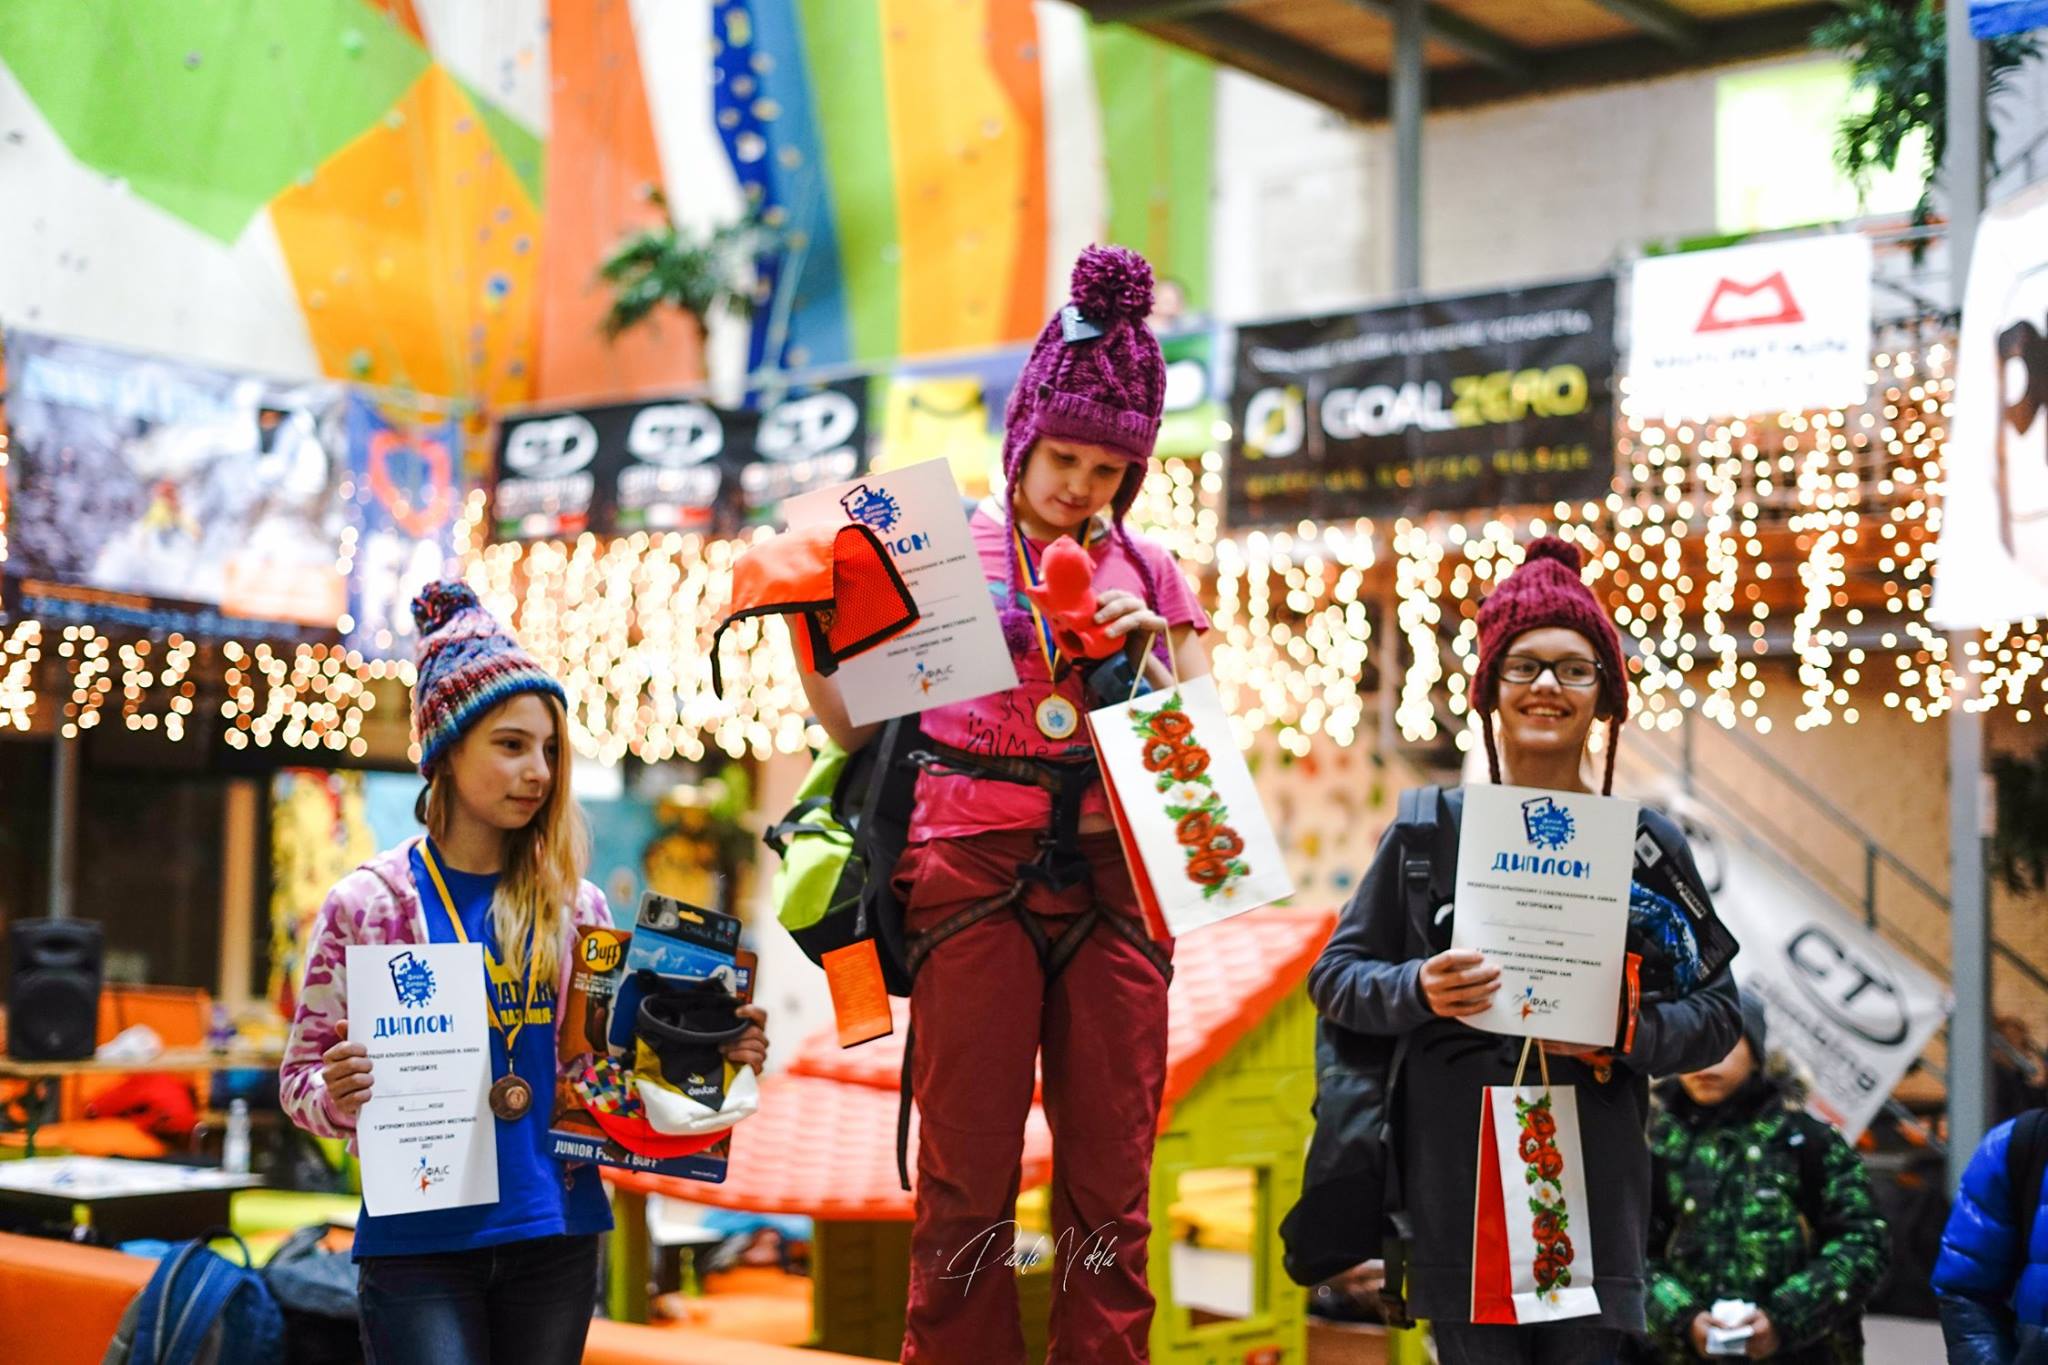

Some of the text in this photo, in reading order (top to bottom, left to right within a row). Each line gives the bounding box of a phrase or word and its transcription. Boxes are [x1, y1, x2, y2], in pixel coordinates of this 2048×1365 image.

[1491, 852, 1590, 880] ДИПЛОМ
[373, 1014, 454, 1040] ДИПЛОМ
[554, 1140, 594, 1158] JUNIOR
